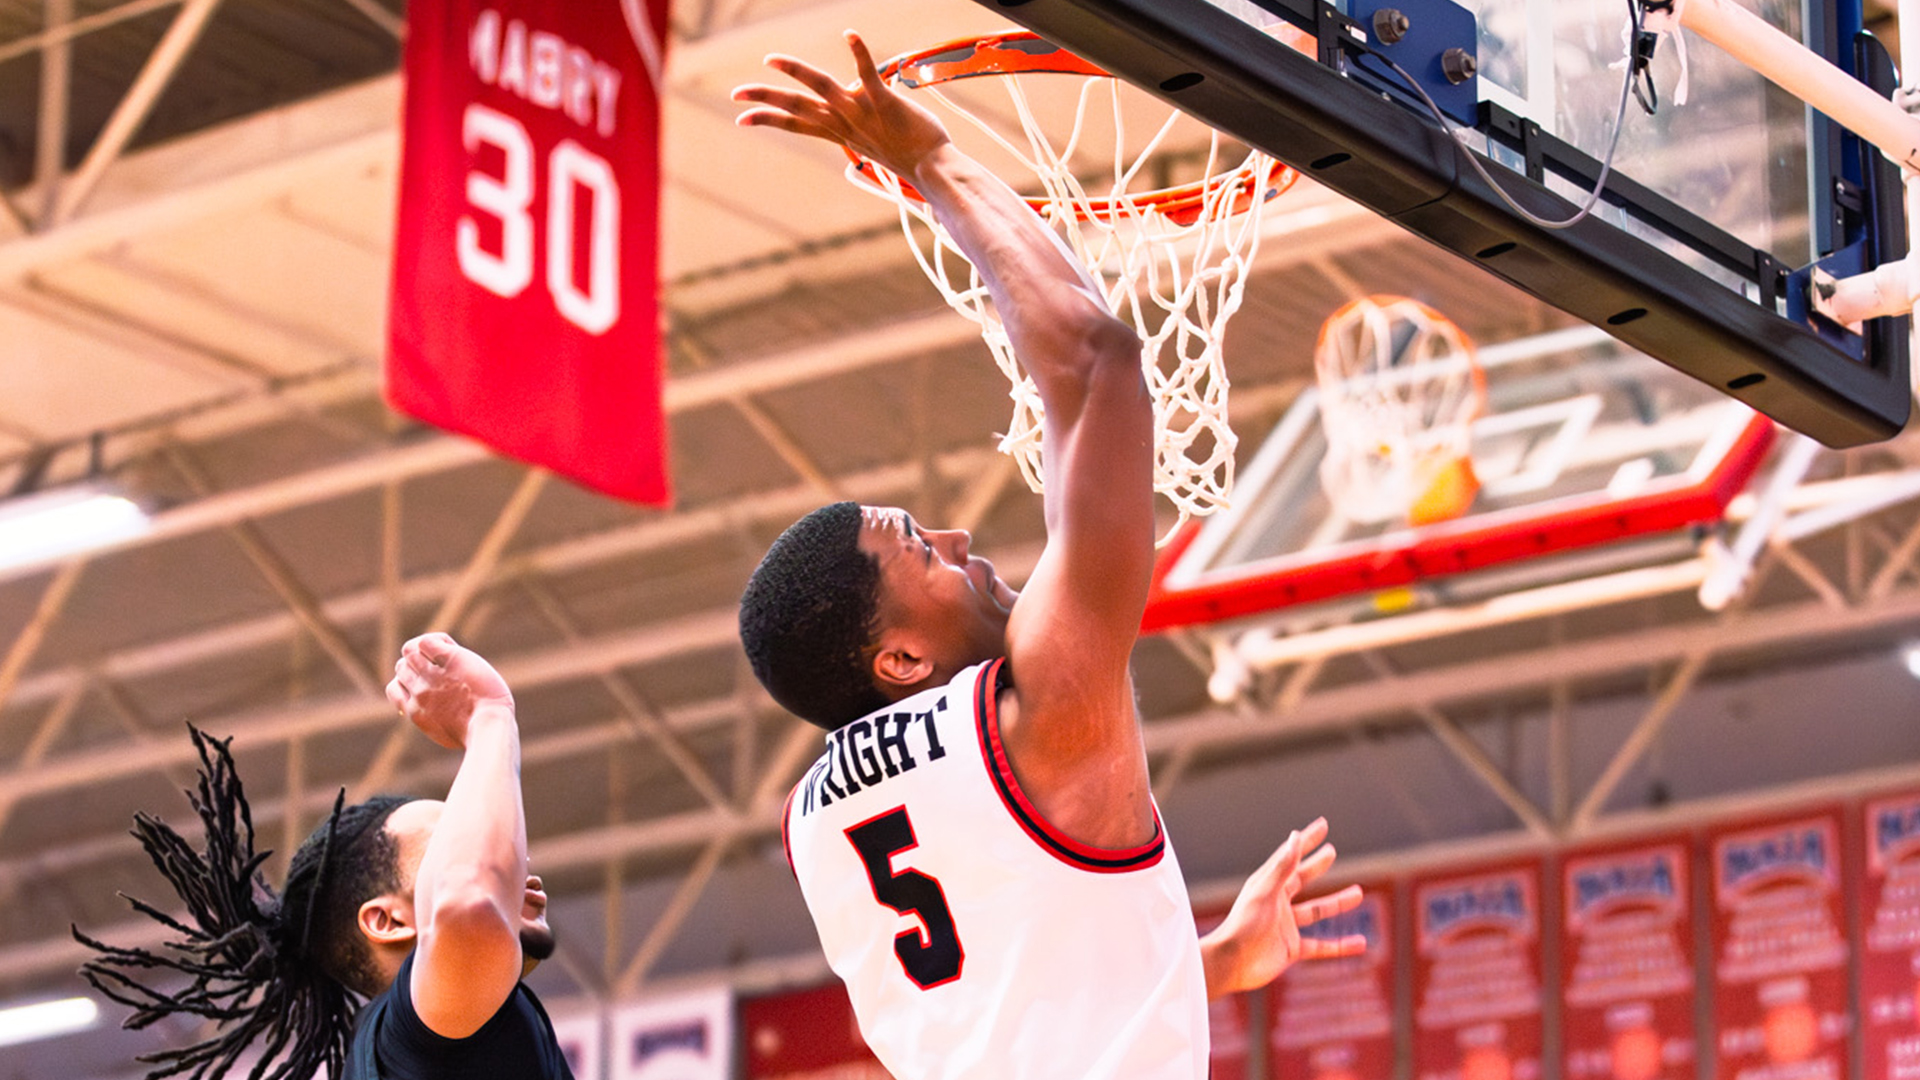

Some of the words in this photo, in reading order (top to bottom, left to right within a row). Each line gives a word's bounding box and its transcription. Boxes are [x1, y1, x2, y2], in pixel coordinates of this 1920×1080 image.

[456, 103, 621, 335] 30
[803, 695, 948, 817] WRIGHT
[843, 804, 965, 991] 5
